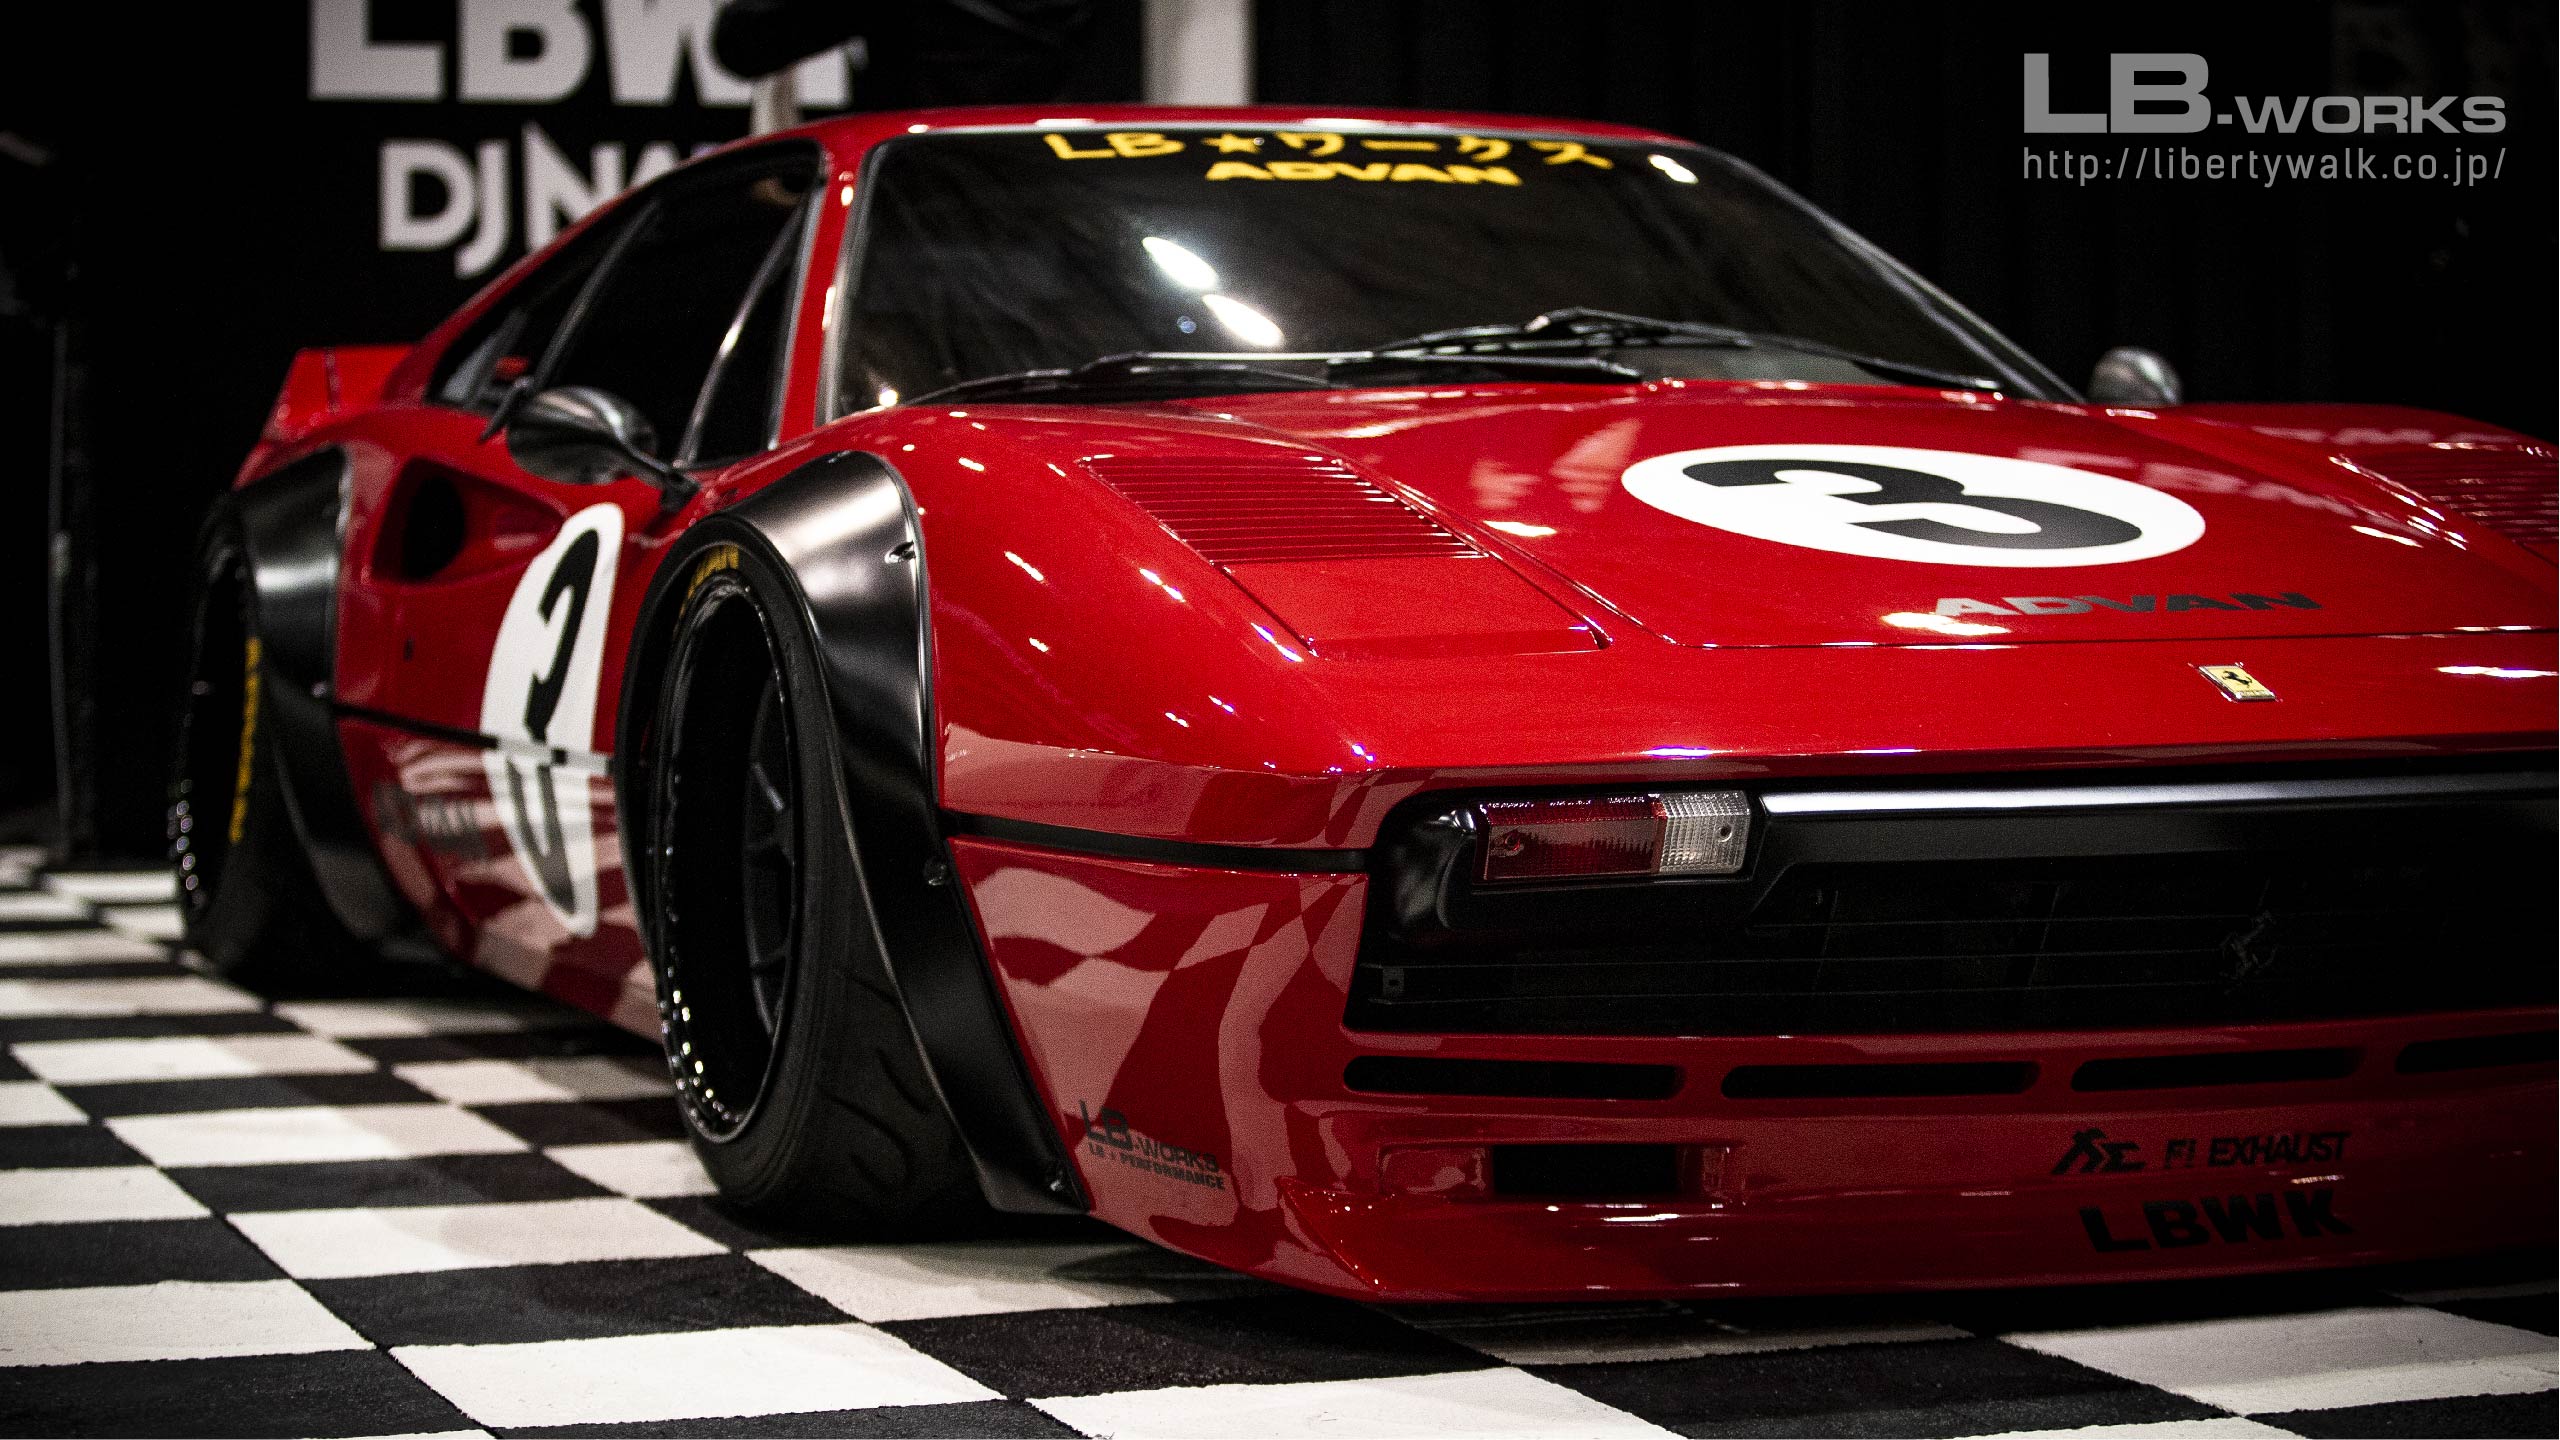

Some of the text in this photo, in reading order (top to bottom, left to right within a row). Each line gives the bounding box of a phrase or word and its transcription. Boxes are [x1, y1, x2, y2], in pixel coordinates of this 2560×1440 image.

[1044, 131, 1612, 169] LB ワークス
[1204, 161, 1524, 186] ADVAN
[1682, 459, 2143, 549] 3
[1932, 592, 2322, 617] ADVAN
[507, 529, 599, 914] 3
[2207, 1131, 2352, 1168] EXHAUST
[1120, 1152, 1226, 1190] PERFORMANCE
[2079, 1189, 2356, 1252] LBWK
